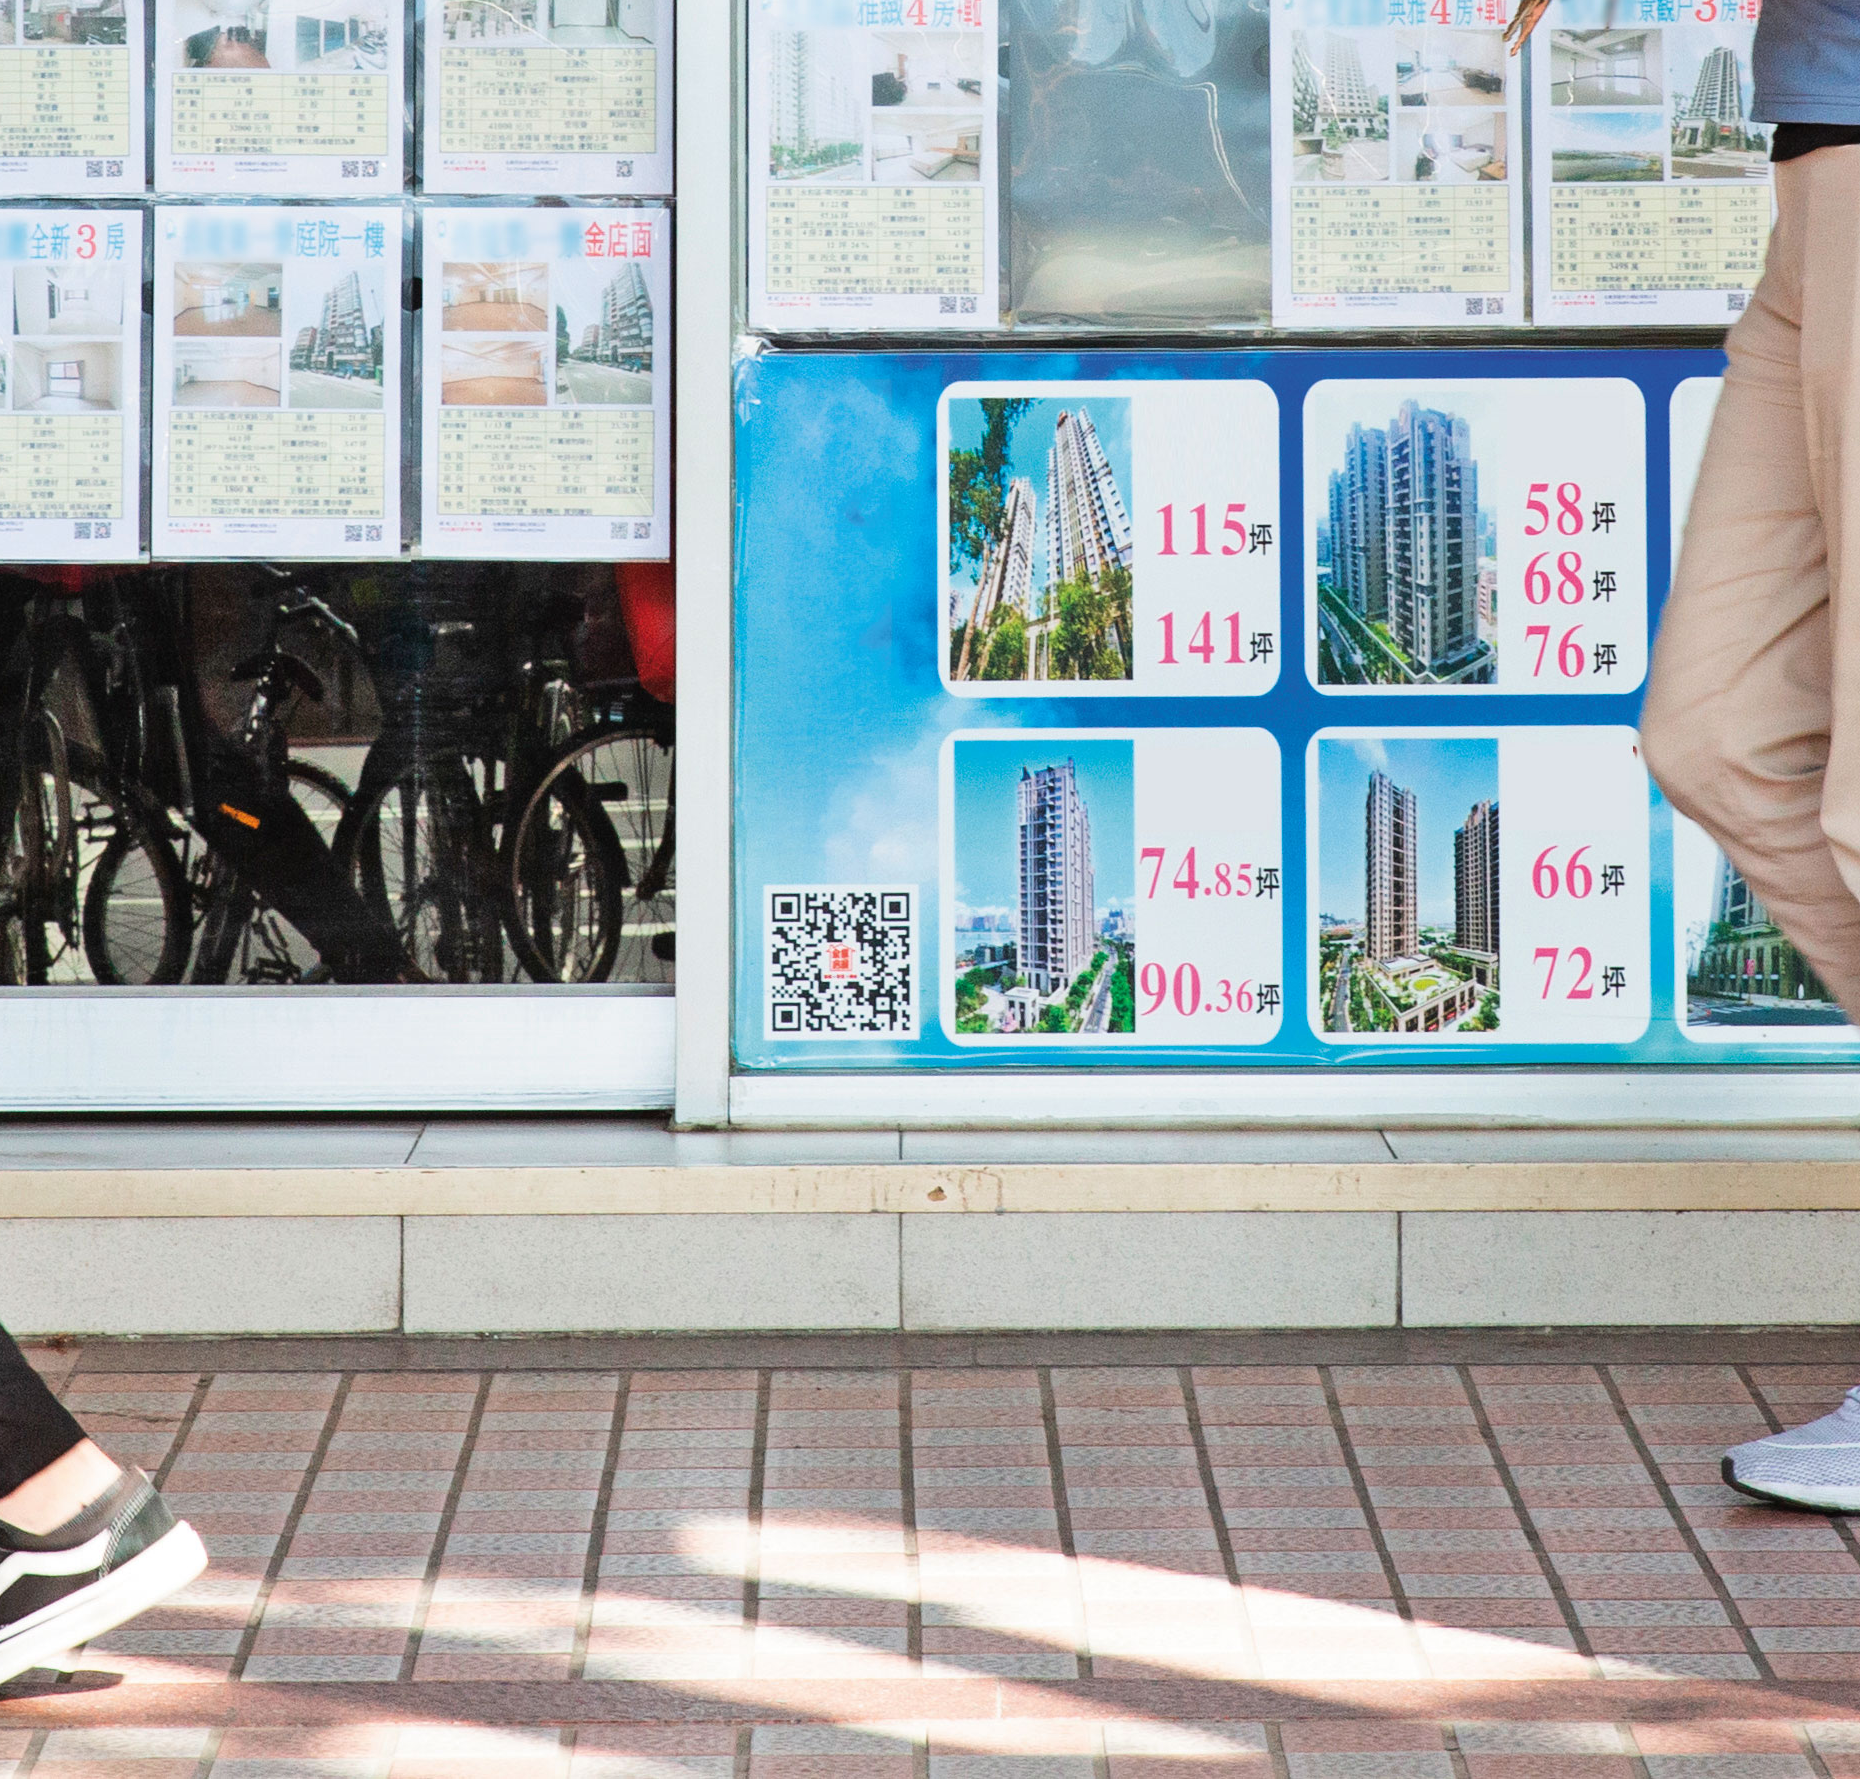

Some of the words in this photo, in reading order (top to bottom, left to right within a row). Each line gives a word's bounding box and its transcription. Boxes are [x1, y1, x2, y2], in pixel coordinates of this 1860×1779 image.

[296, 220, 386, 259] 庭院一樓
[584, 222, 653, 259] 金店面
[1156, 503, 1273, 556] 115坪
[1523, 482, 1617, 536] 58坪
[1523, 551, 1617, 605] 68坪
[1157, 611, 1274, 664] 141坪
[1524, 624, 1618, 678] 76坪
[1140, 847, 1281, 900] 74.85坪
[1532, 845, 1625, 899] 66坪
[1140, 963, 1281, 1016] 90.36坪
[1533, 947, 1626, 1000] 72坪
